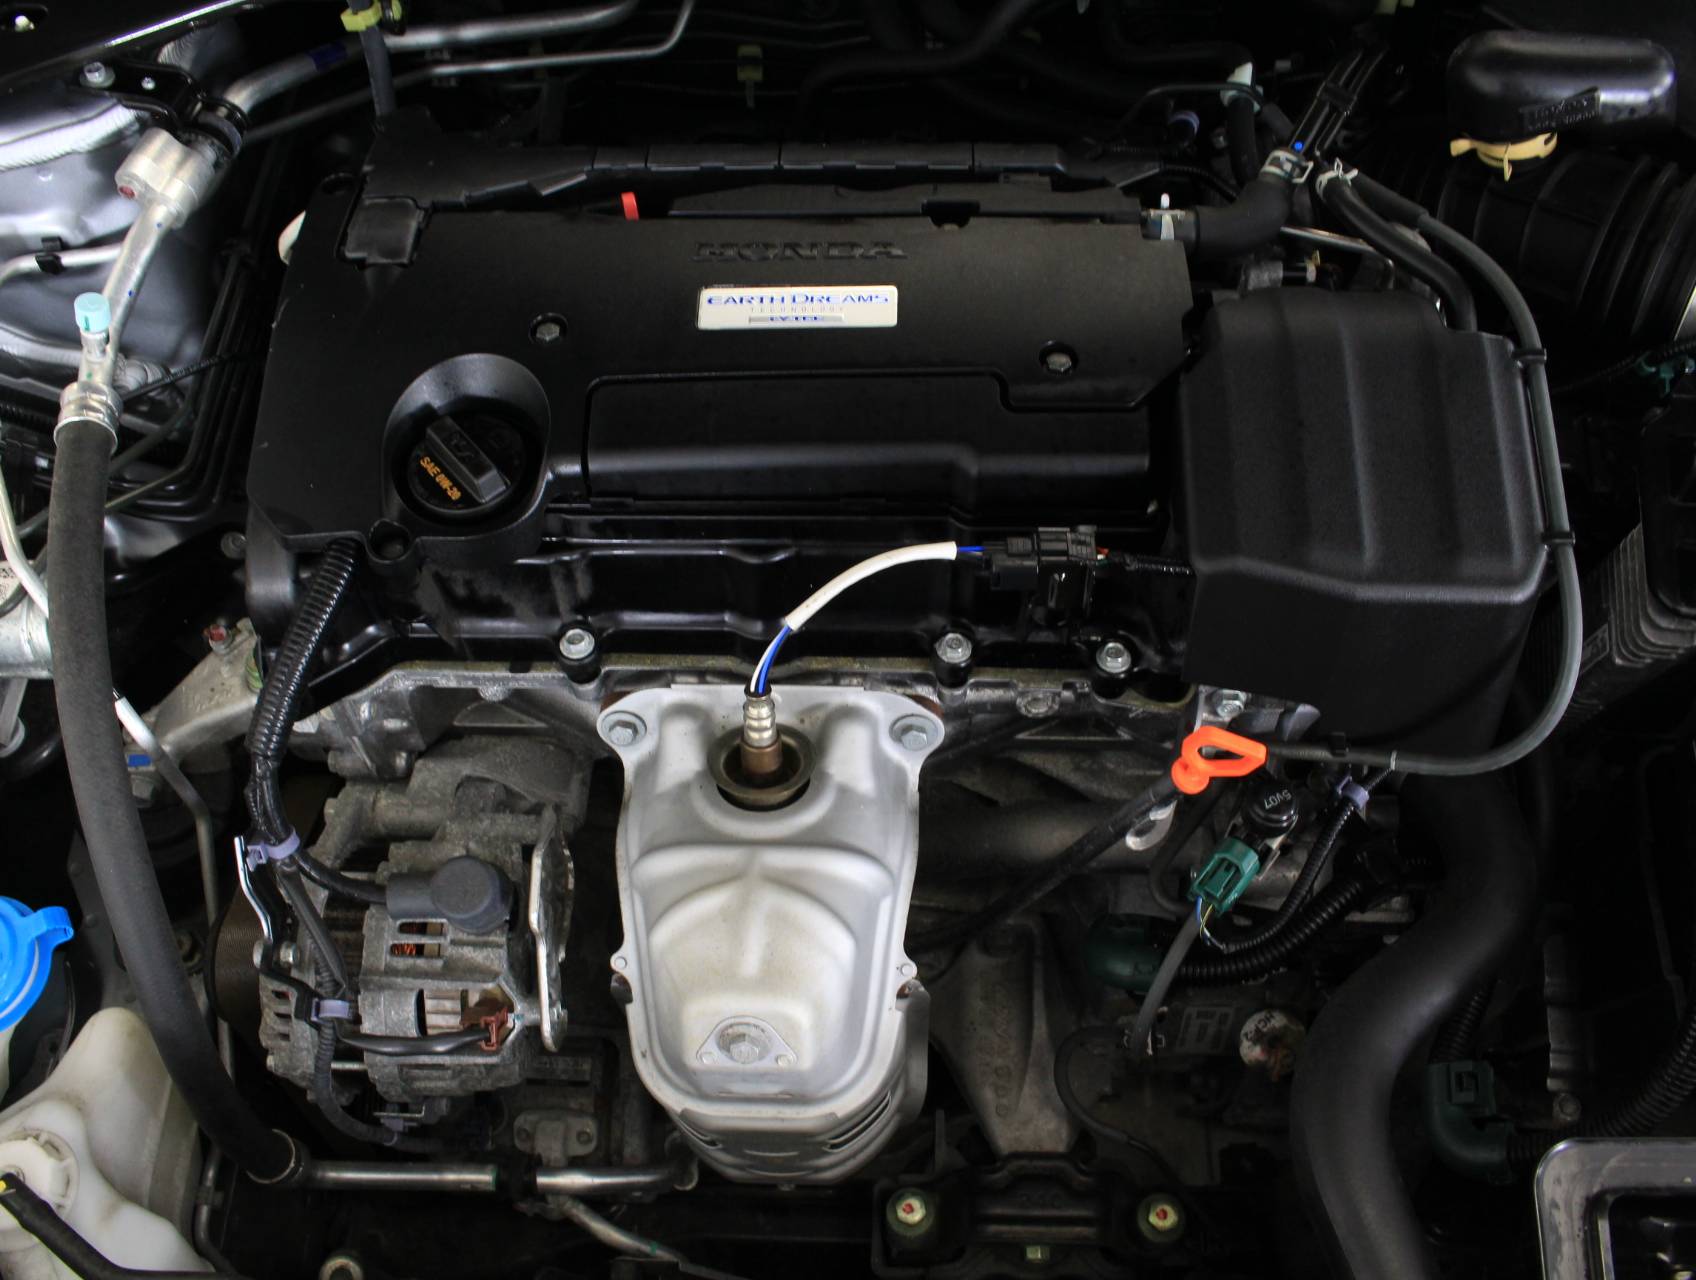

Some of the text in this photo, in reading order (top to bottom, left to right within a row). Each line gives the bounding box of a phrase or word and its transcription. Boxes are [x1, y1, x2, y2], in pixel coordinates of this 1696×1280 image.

[691, 241, 908, 261] HONDA
[707, 294, 785, 305] EARTH
[420, 456, 441, 478] SAE
